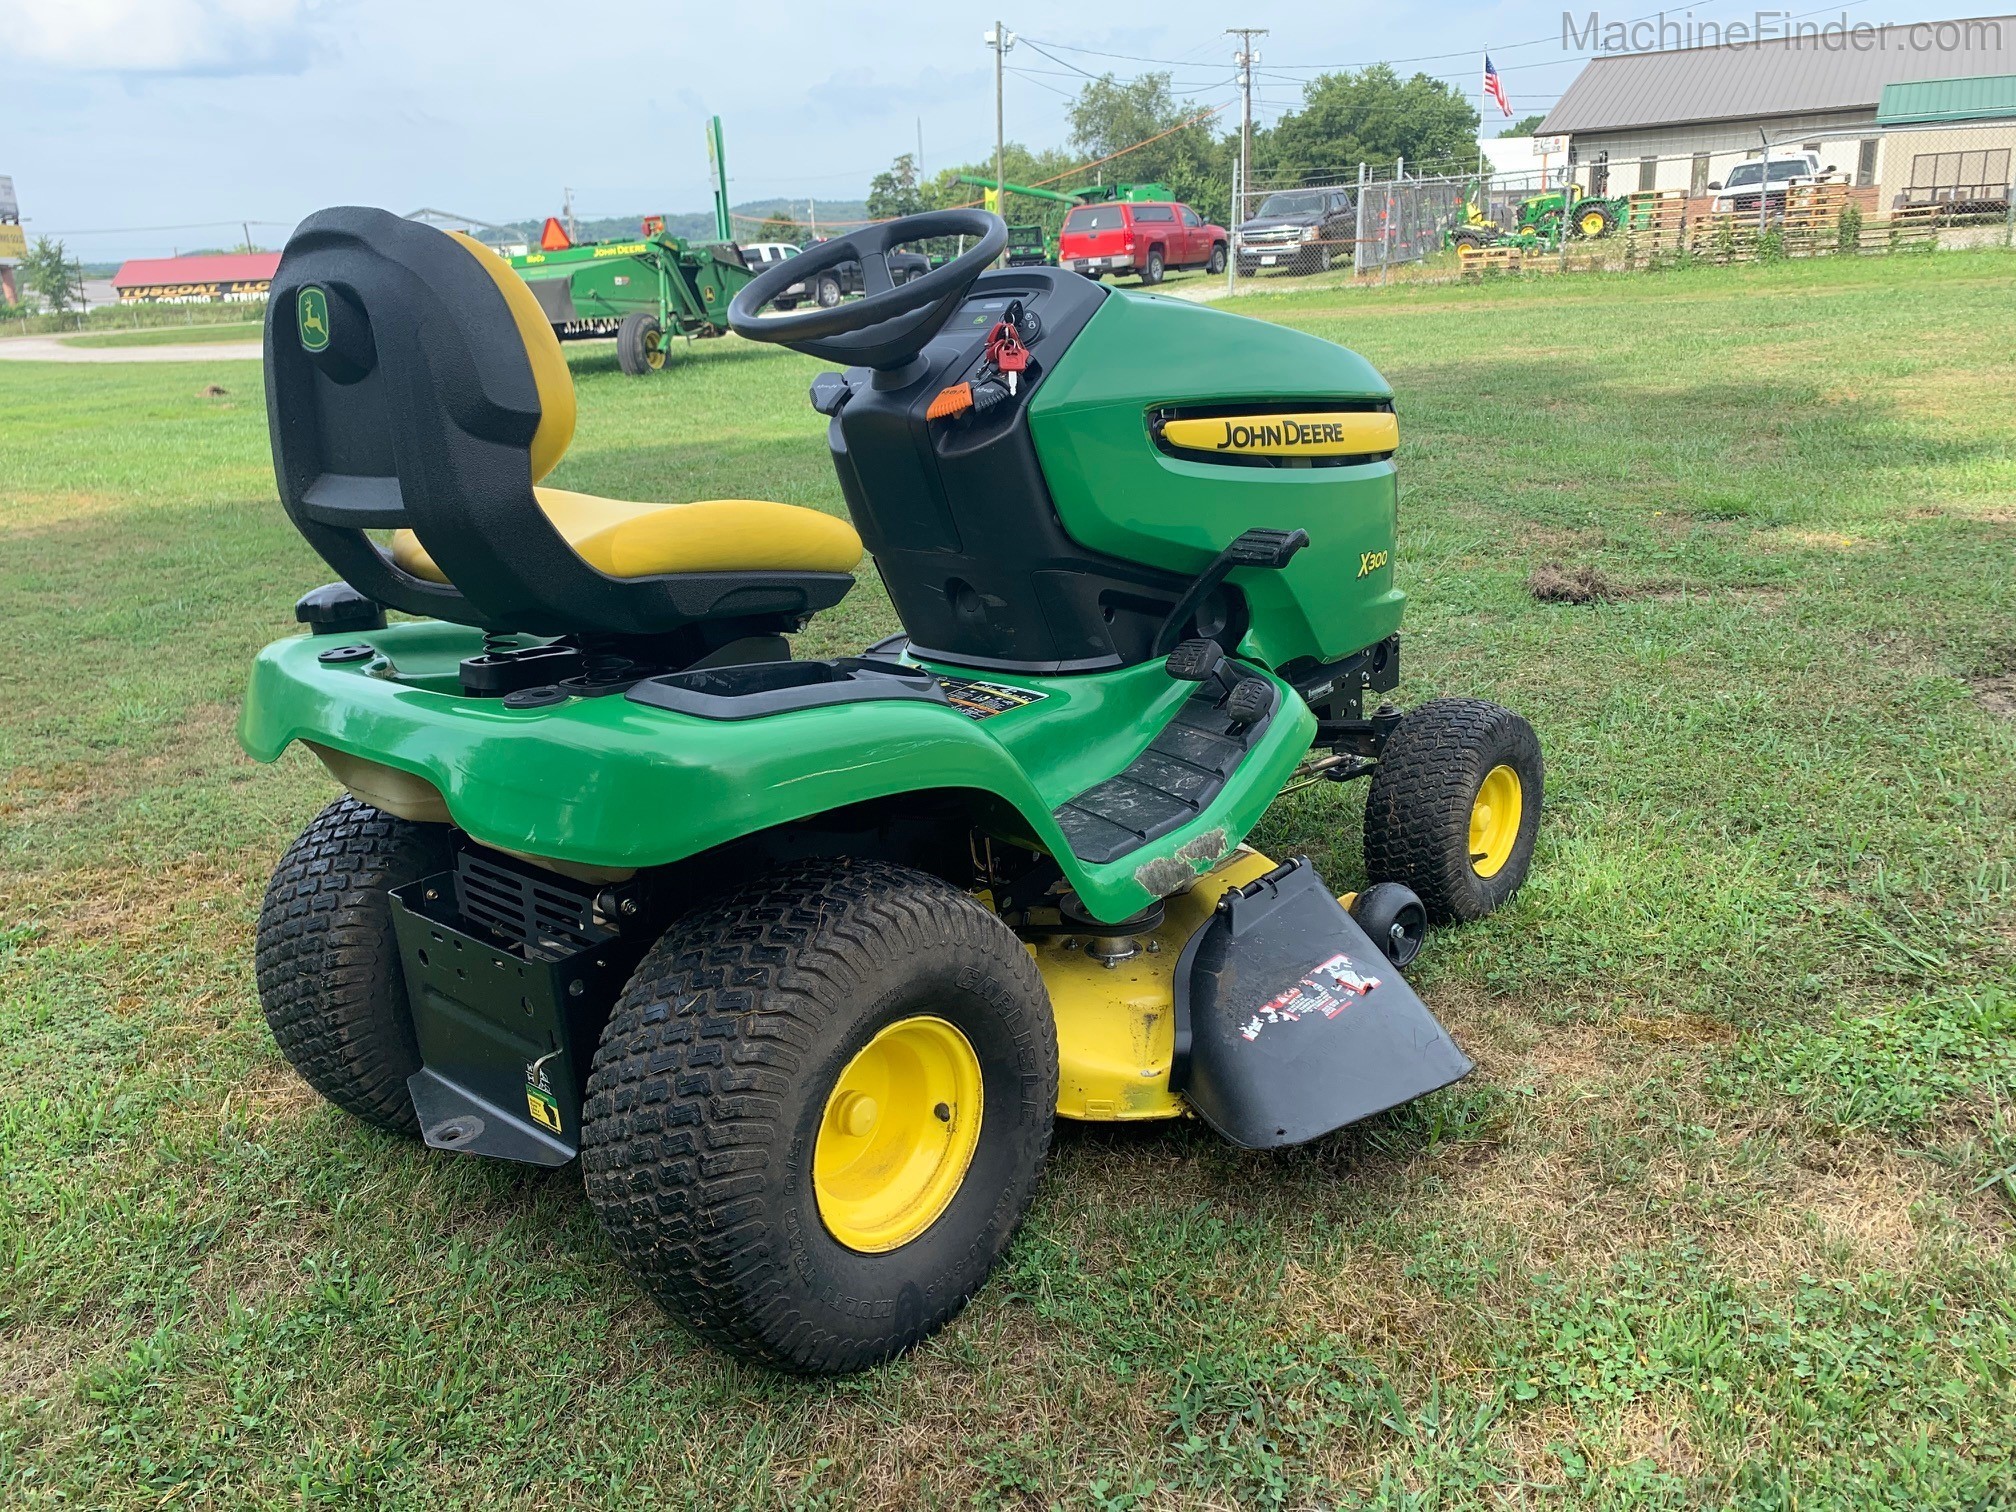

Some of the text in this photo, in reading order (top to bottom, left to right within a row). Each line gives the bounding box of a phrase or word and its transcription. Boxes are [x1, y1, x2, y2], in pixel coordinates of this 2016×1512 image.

[594, 244, 647, 258] JOHN DEERE
[120, 281, 271, 297] TUSCOAT LLC
[1217, 420, 1345, 449] JOHN DEERE
[1356, 550, 1388, 580] X300
[954, 965, 1038, 1127] CARLISLE
[784, 1206, 818, 1288] TRAC
[820, 1285, 894, 1320] MULTI
